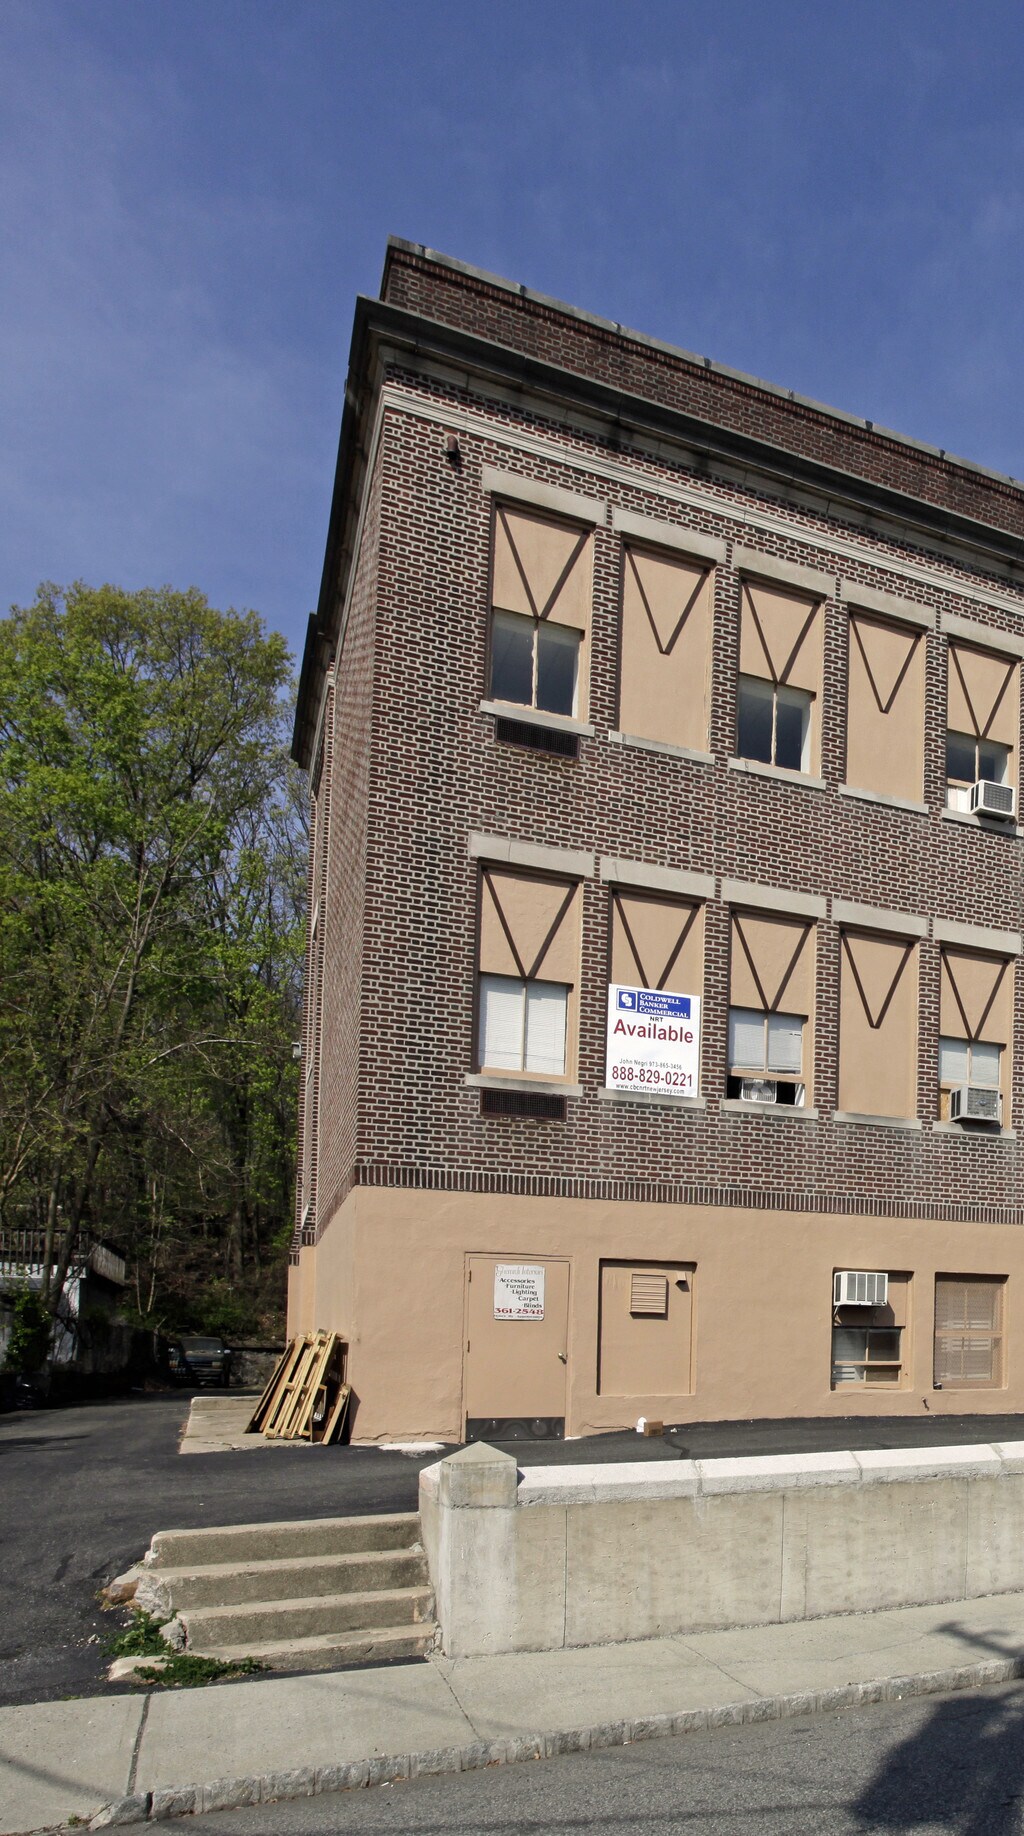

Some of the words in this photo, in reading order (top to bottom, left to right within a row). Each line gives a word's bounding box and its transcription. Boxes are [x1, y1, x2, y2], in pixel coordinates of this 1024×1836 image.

[639, 993, 681, 1005] COLDWELL
[639, 1000, 669, 1010] BANKER
[639, 1006, 689, 1019] COMMERCIAL
[613, 1018, 693, 1043] Available
[612, 1065, 692, 1087] 888-829-0221
[615, 1083, 685, 1095] www.cbcnrtnewjersey.com
[499, 1277, 536, 1285] Accessories
[495, 1307, 545, 1315] 361-2548
